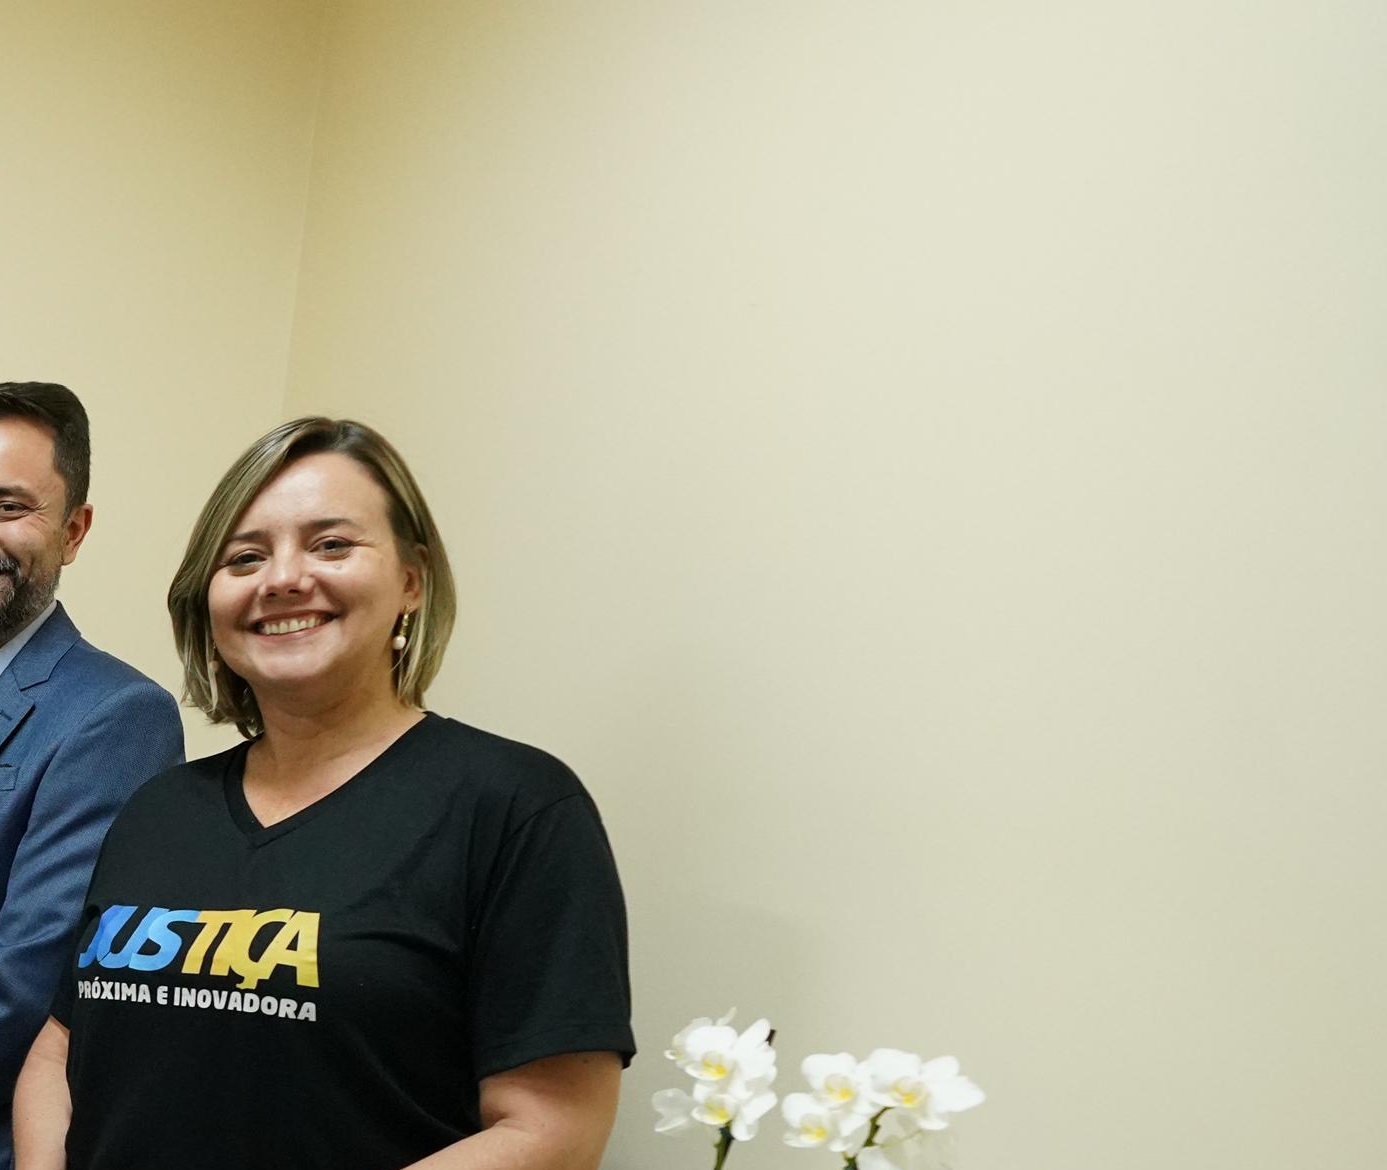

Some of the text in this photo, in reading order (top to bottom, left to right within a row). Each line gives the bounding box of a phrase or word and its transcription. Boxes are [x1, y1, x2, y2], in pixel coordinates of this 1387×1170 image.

[77, 904, 321, 989] JUSTIÇA
[77, 976, 317, 1022] PRÓXIMA E INOVADORA
